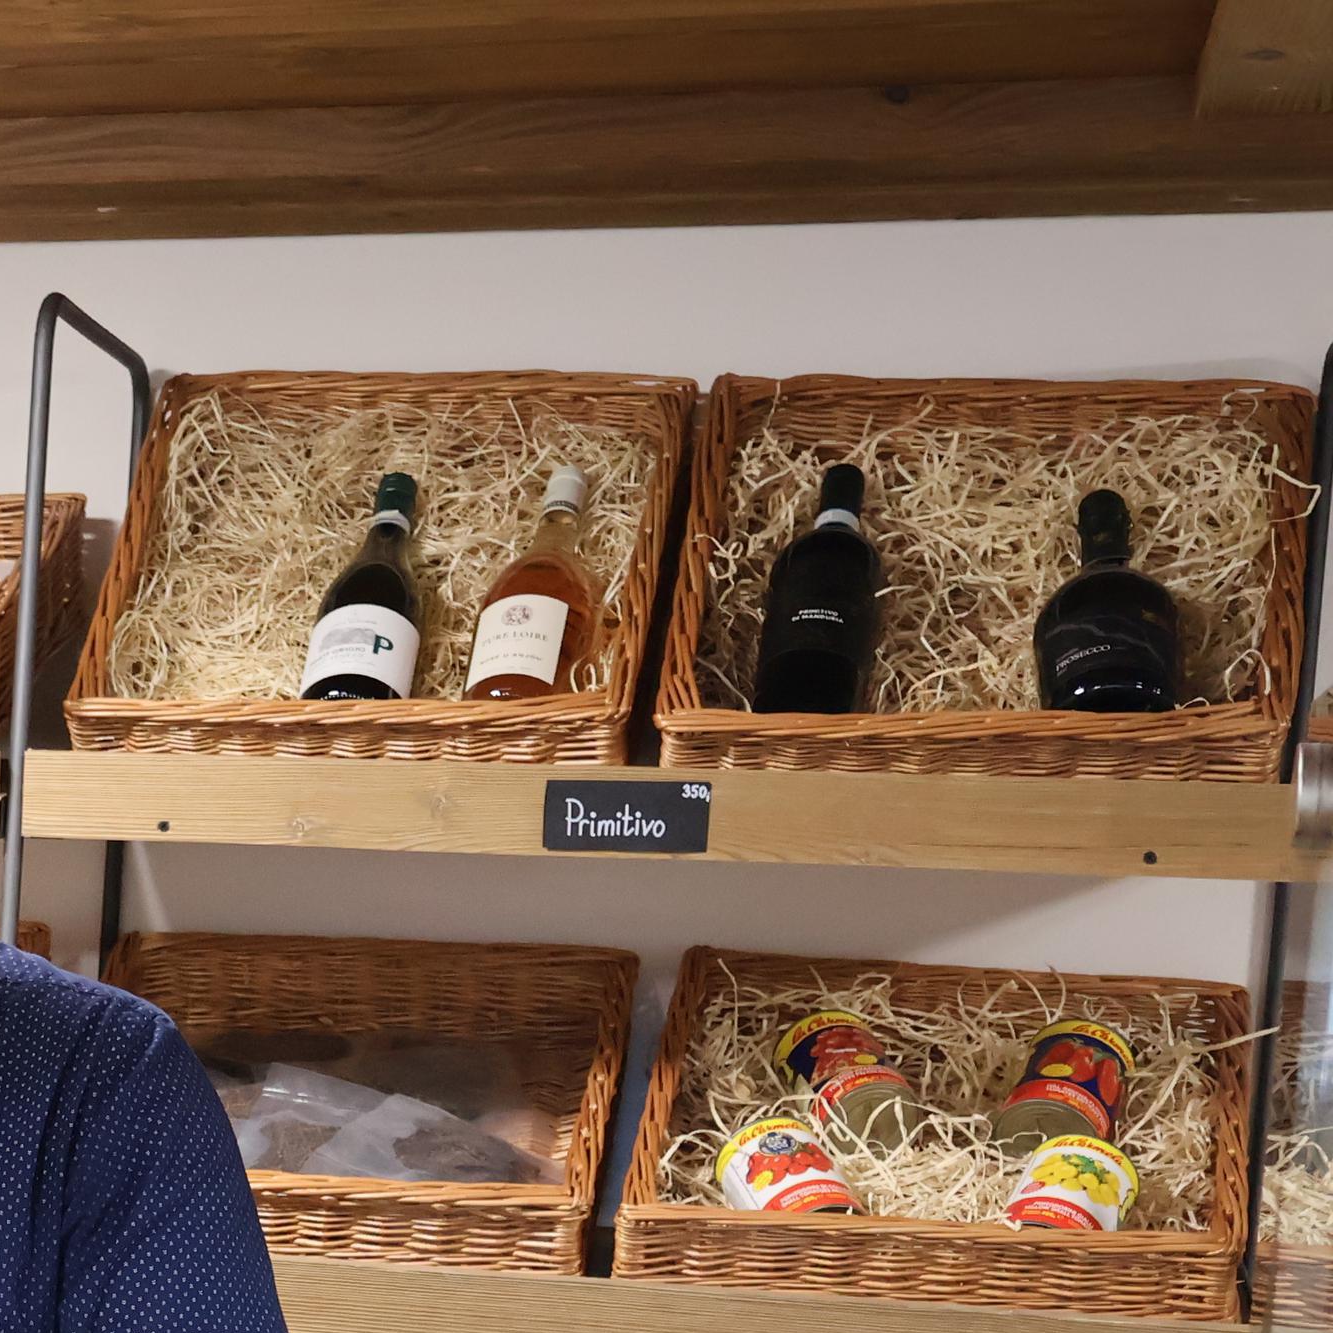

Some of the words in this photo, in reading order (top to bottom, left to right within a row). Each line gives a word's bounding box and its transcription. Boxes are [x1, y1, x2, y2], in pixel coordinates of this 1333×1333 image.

[372, 633, 394, 655] P
[1055, 645, 1111, 672] PROSECCO
[564, 797, 667, 838] Primitivo
